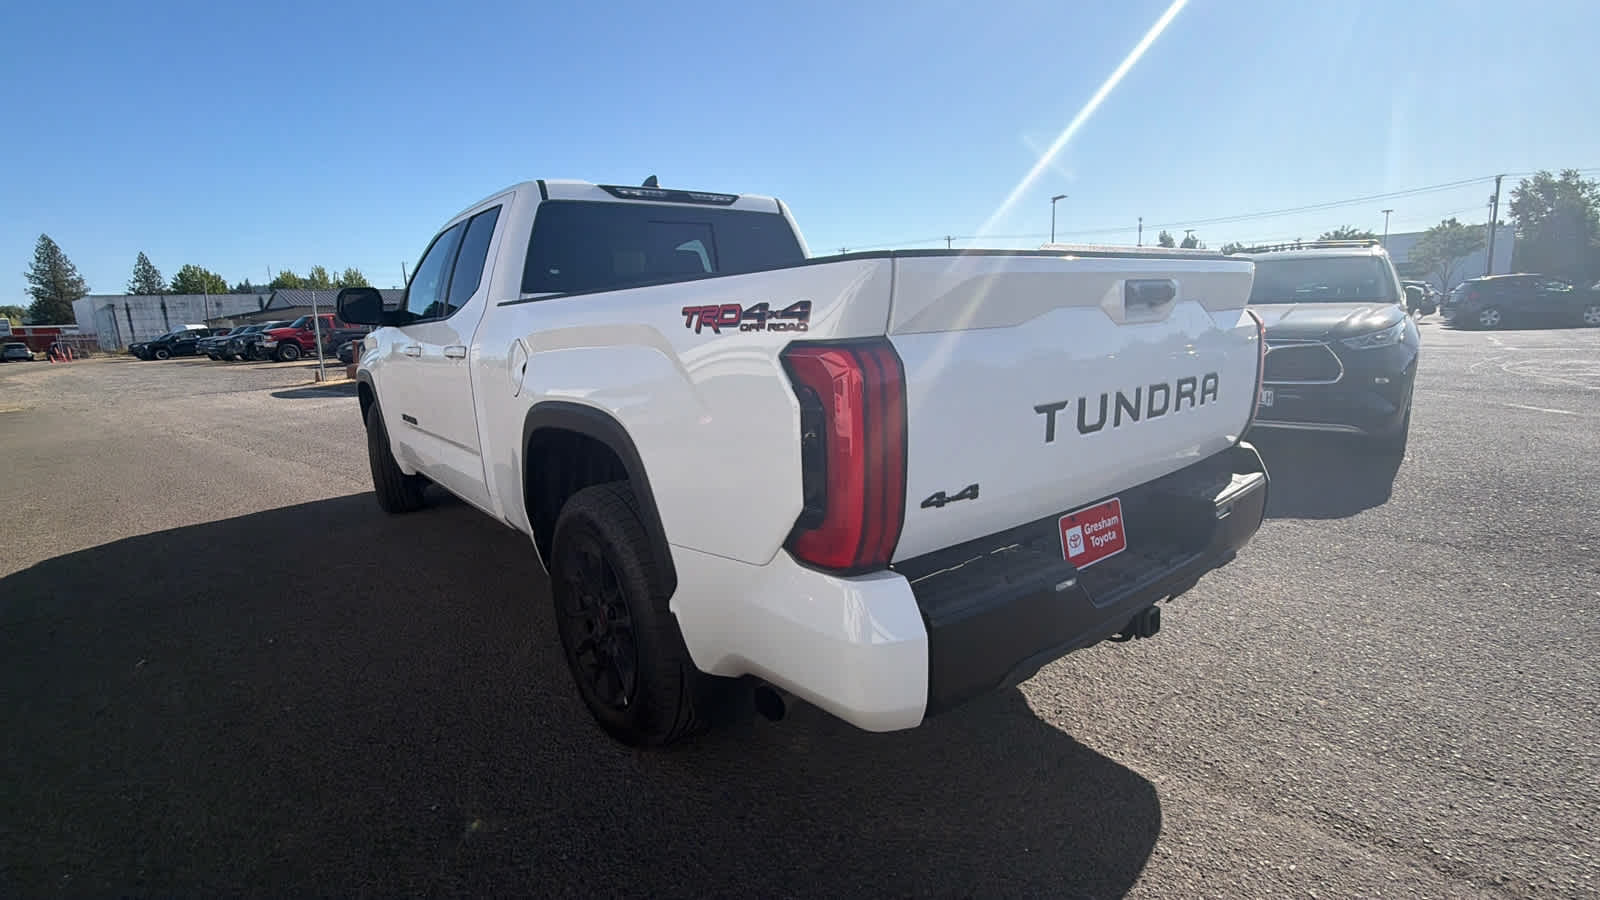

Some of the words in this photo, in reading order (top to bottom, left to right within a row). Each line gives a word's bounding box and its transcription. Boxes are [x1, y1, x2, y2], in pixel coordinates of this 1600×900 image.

[682, 304, 742, 334] TRD
[740, 322, 766, 332] OFF
[767, 322, 808, 332] ROAD
[1033, 372, 1219, 443] TUNDRA
[1084, 516, 1119, 535] Gresham
[1090, 531, 1117, 547] Toyota
